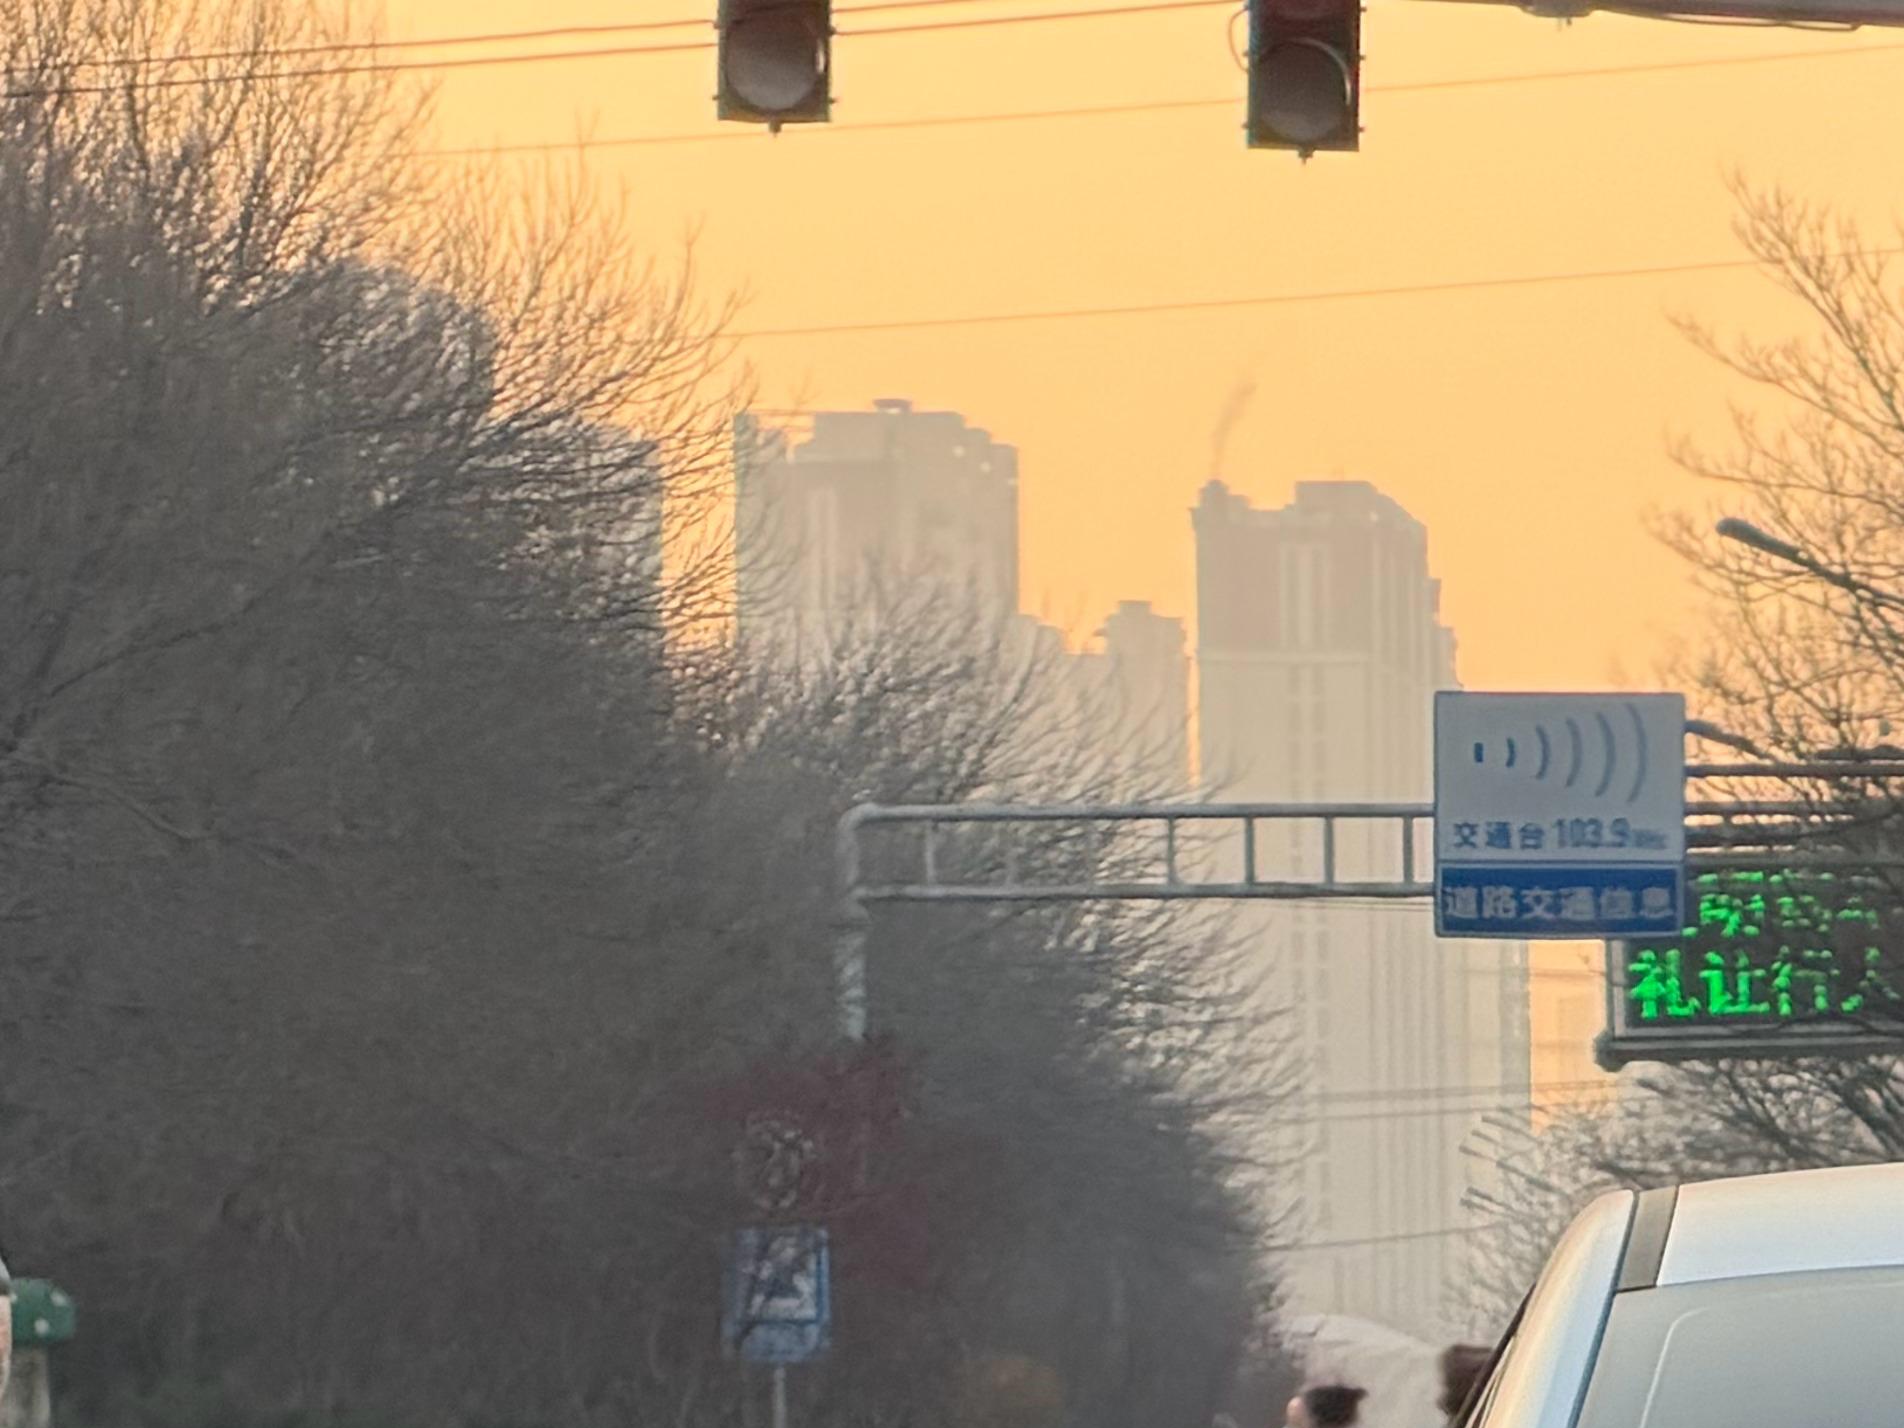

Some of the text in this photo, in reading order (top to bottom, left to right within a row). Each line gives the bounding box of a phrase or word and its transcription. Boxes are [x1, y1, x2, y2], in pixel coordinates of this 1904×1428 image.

[1454, 822, 1545, 849] 交通台
[1442, 886, 1675, 921] 道路交通信息
